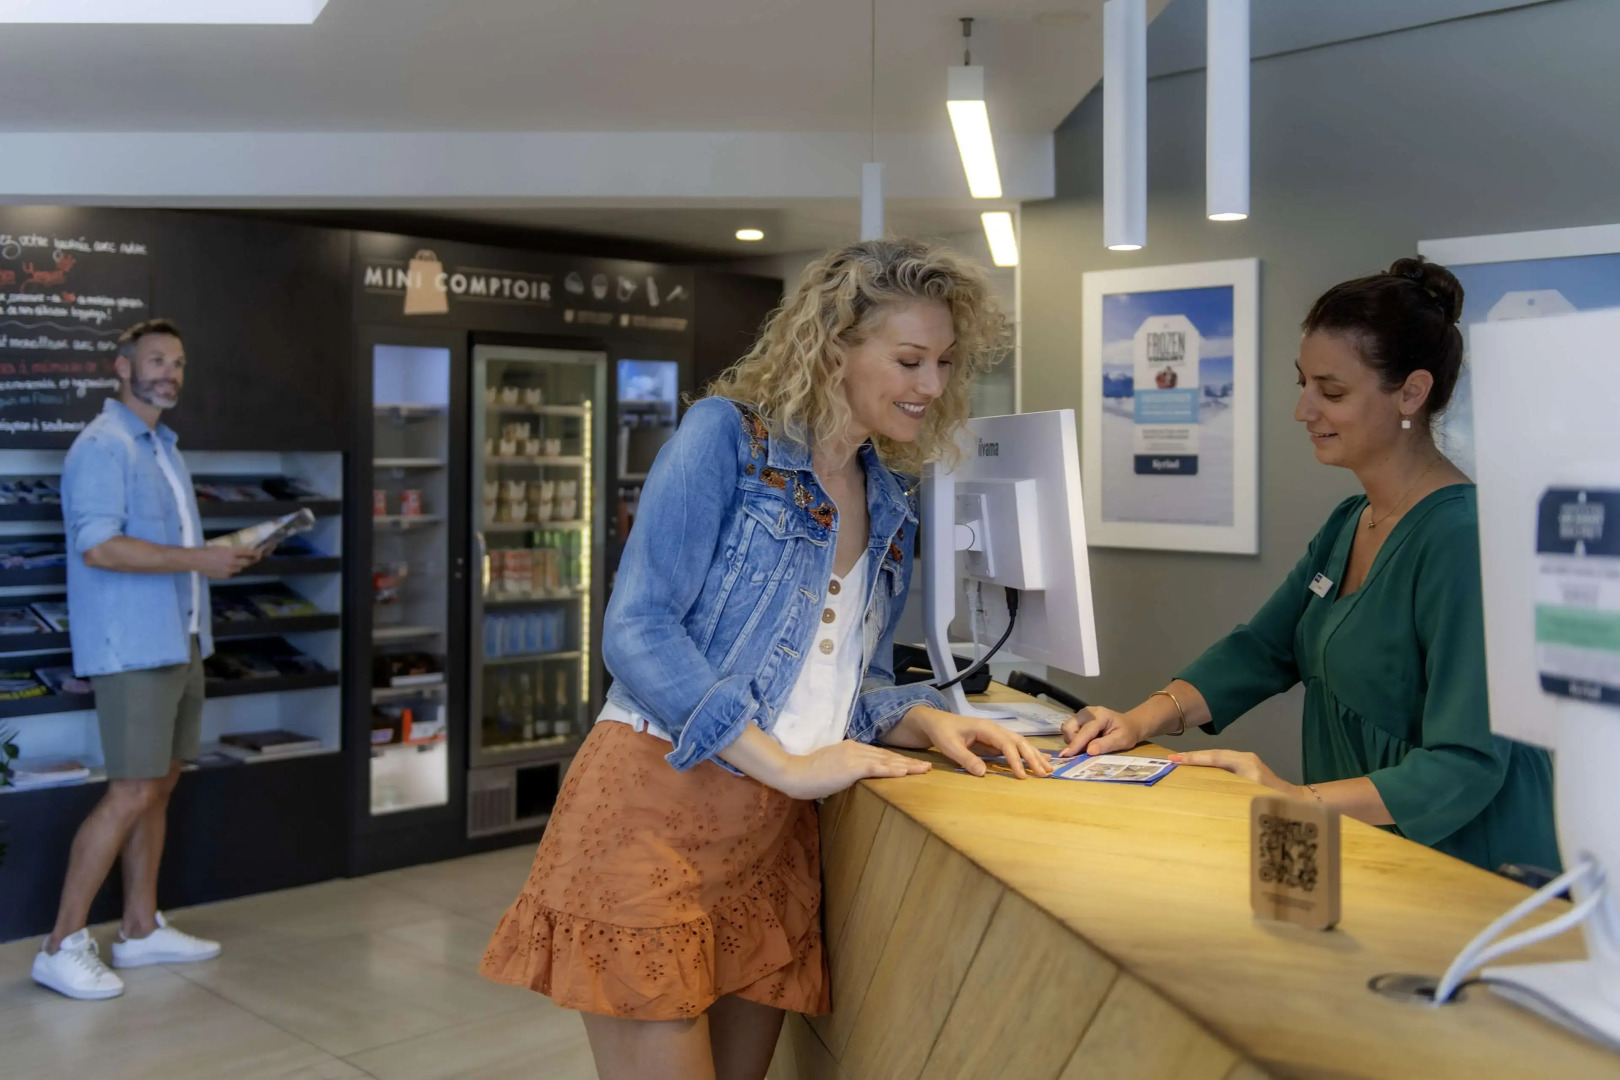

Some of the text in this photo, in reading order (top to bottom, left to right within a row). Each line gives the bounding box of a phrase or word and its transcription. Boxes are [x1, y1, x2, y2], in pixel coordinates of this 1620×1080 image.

[364, 266, 551, 300] MINI COMPTOIR
[1147, 331, 1186, 356] FROZEN
